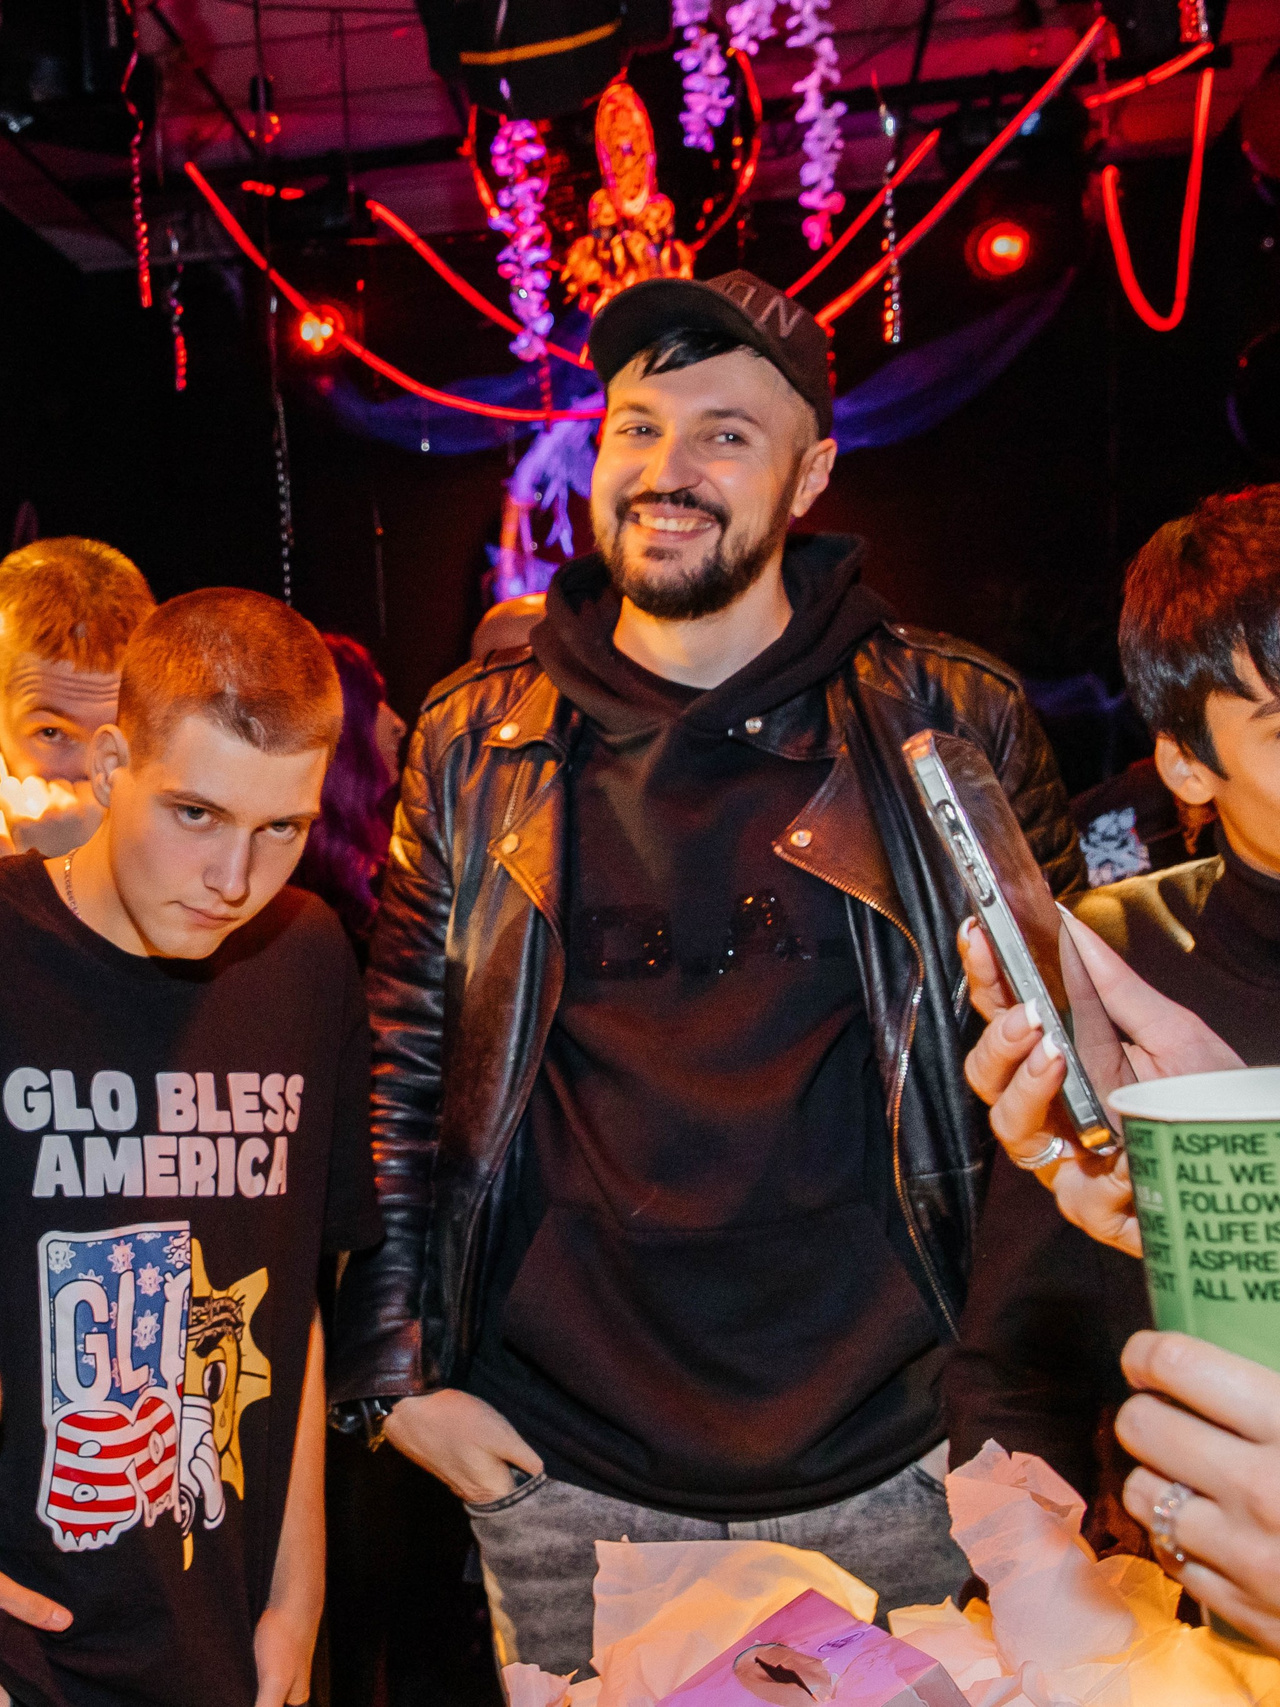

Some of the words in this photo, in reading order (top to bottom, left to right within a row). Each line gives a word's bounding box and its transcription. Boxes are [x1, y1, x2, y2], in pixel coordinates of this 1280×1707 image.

[3, 1067, 138, 1131] GLO
[155, 1071, 304, 1133] BLESS
[1172, 1133, 1268, 1156] ASPIRE
[32, 1135, 289, 1198] AMERICA
[1177, 1163, 1222, 1186] ALL
[1229, 1162, 1276, 1185] WE
[1185, 1220, 1200, 1242] A
[1204, 1221, 1260, 1244] LIFE
[1188, 1249, 1280, 1273] ASPIRE
[1193, 1277, 1238, 1301] ALL
